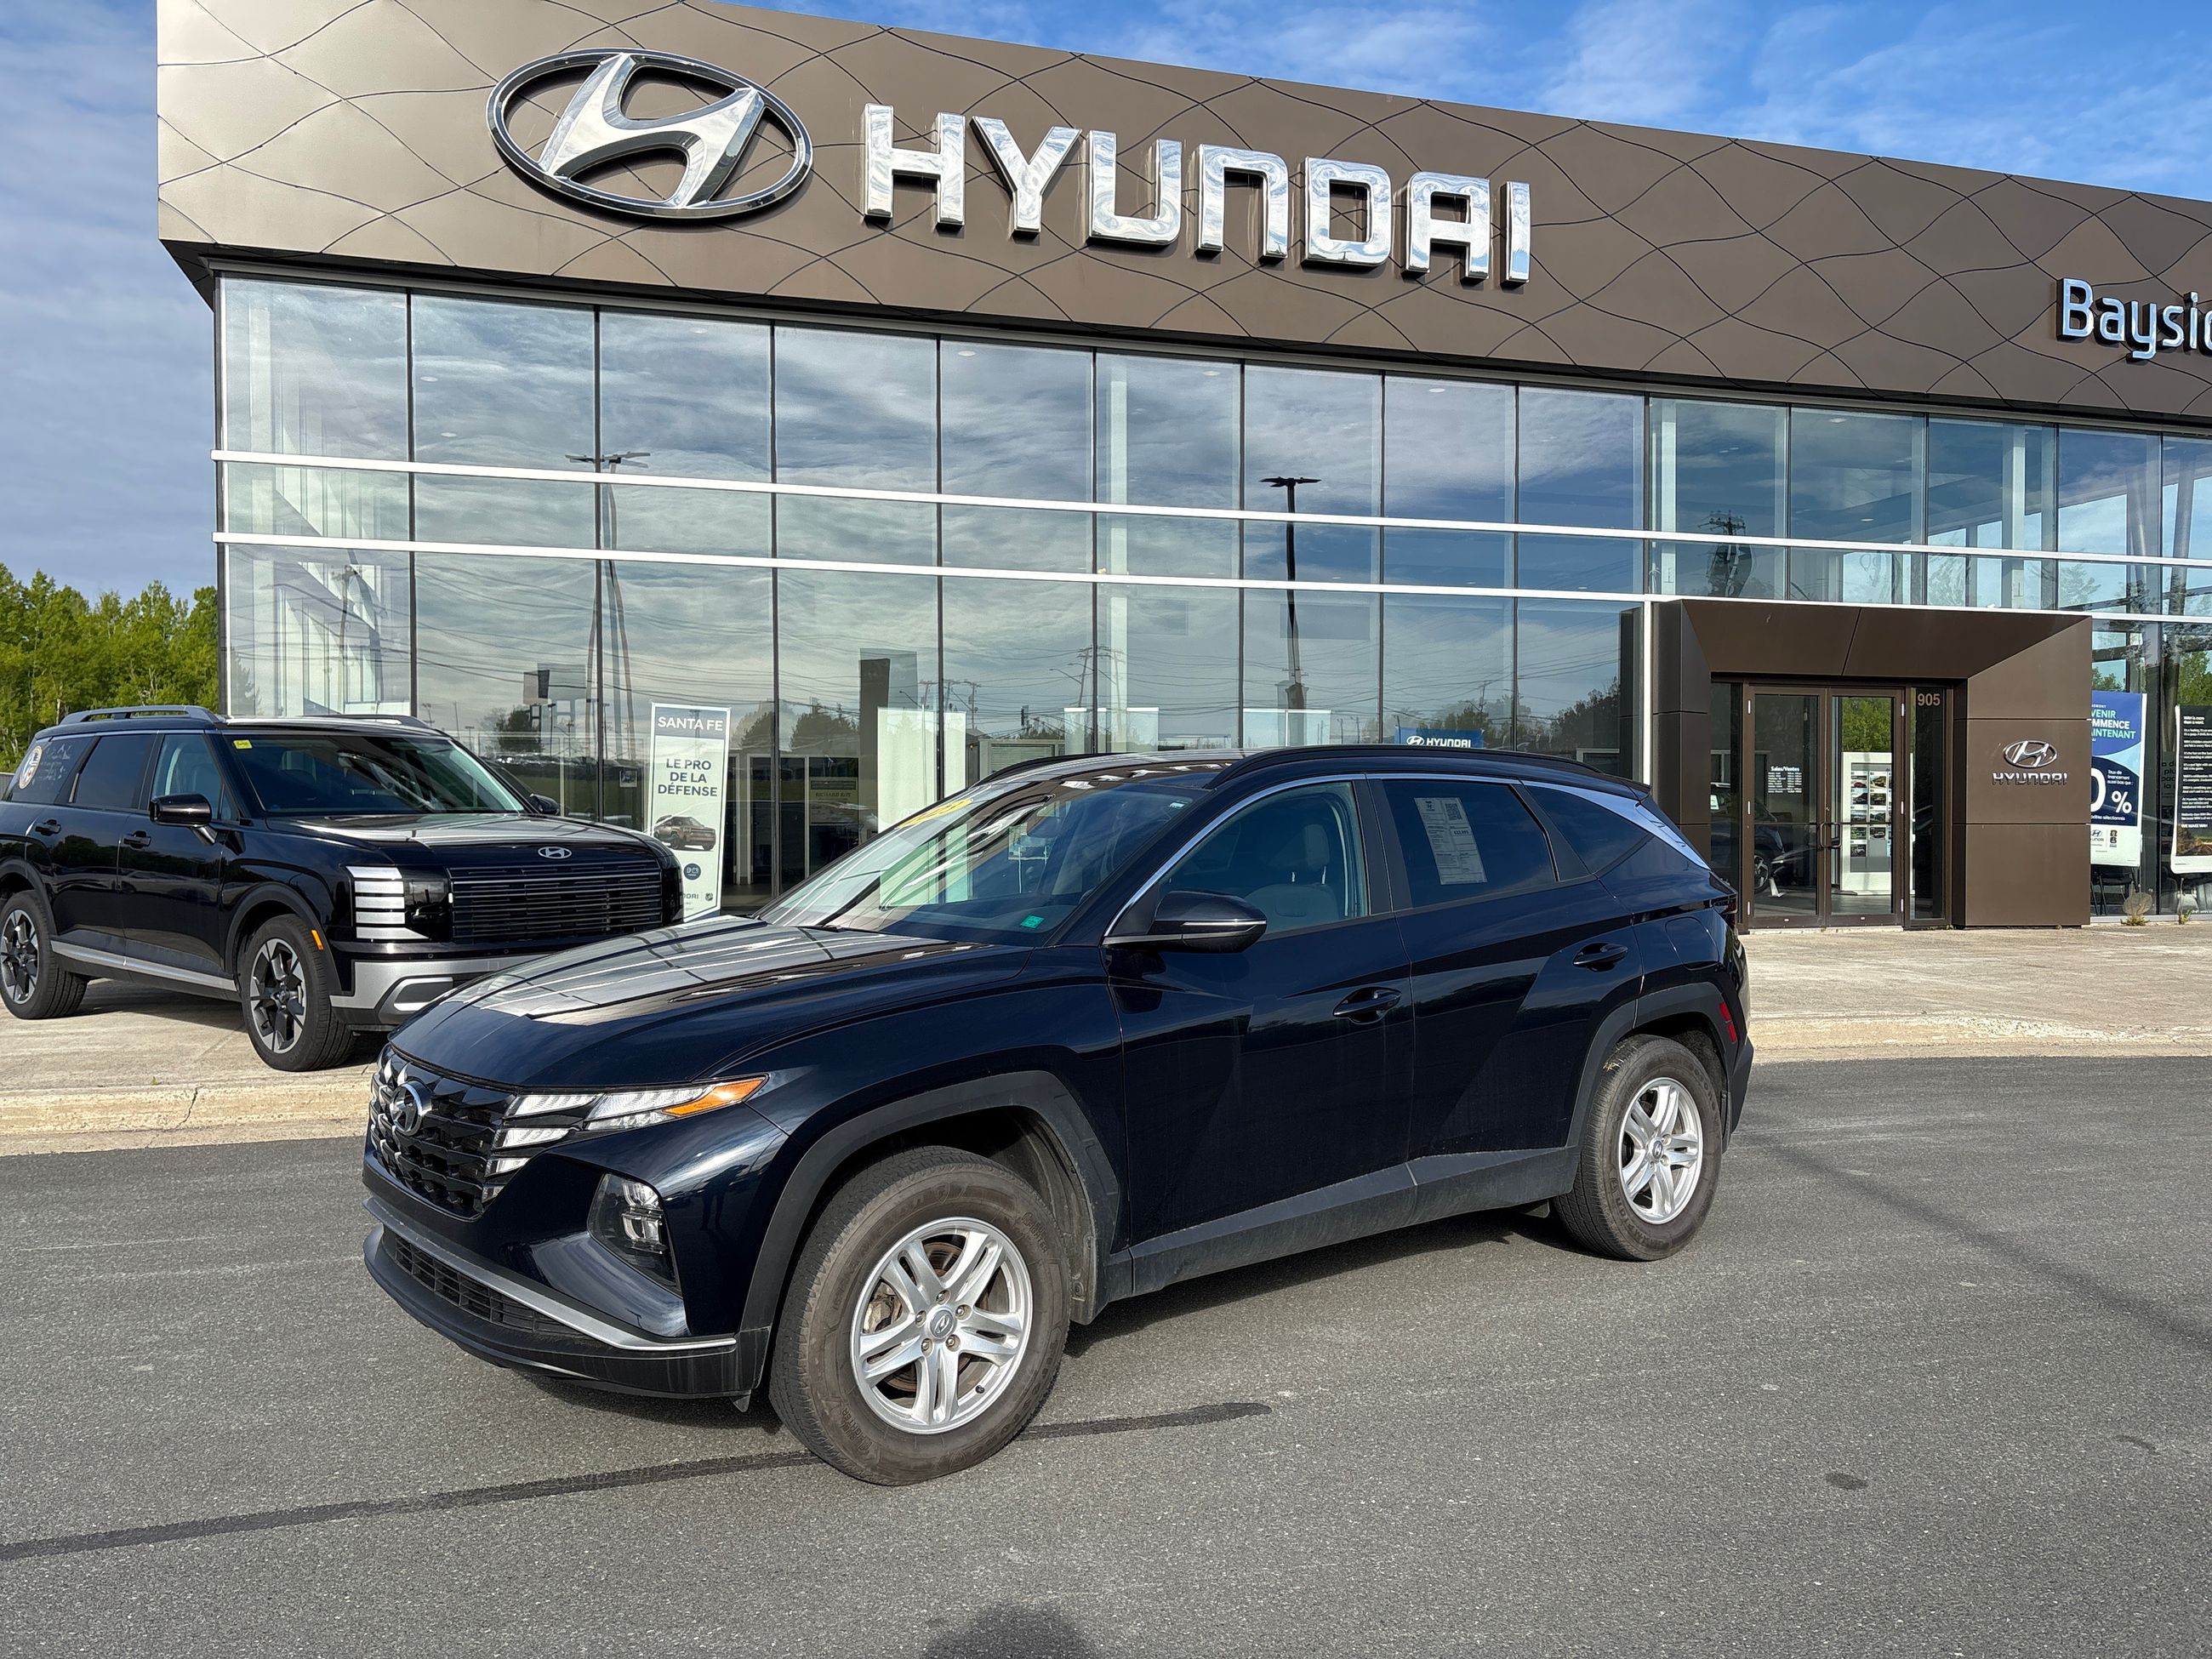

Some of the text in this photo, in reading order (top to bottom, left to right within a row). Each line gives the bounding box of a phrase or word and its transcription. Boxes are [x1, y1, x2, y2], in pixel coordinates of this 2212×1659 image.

[862, 103, 1531, 288] HYUNDAI
[2057, 278, 2212, 362] Baysi
[1918, 693, 1941, 706] 905
[658, 716, 723, 732] SANTA FE
[2091, 718, 2130, 730] MMENCE
[2091, 728, 2136, 739] INTENANT
[1426, 737, 1471, 748] HYUNDAI
[666, 758, 711, 770] LE PRO
[670, 772, 707, 784] DE LA
[1992, 772, 2067, 784] HYUNDAI
[658, 782, 717, 796] DÉFENSE
[2112, 790, 2132, 814] %
